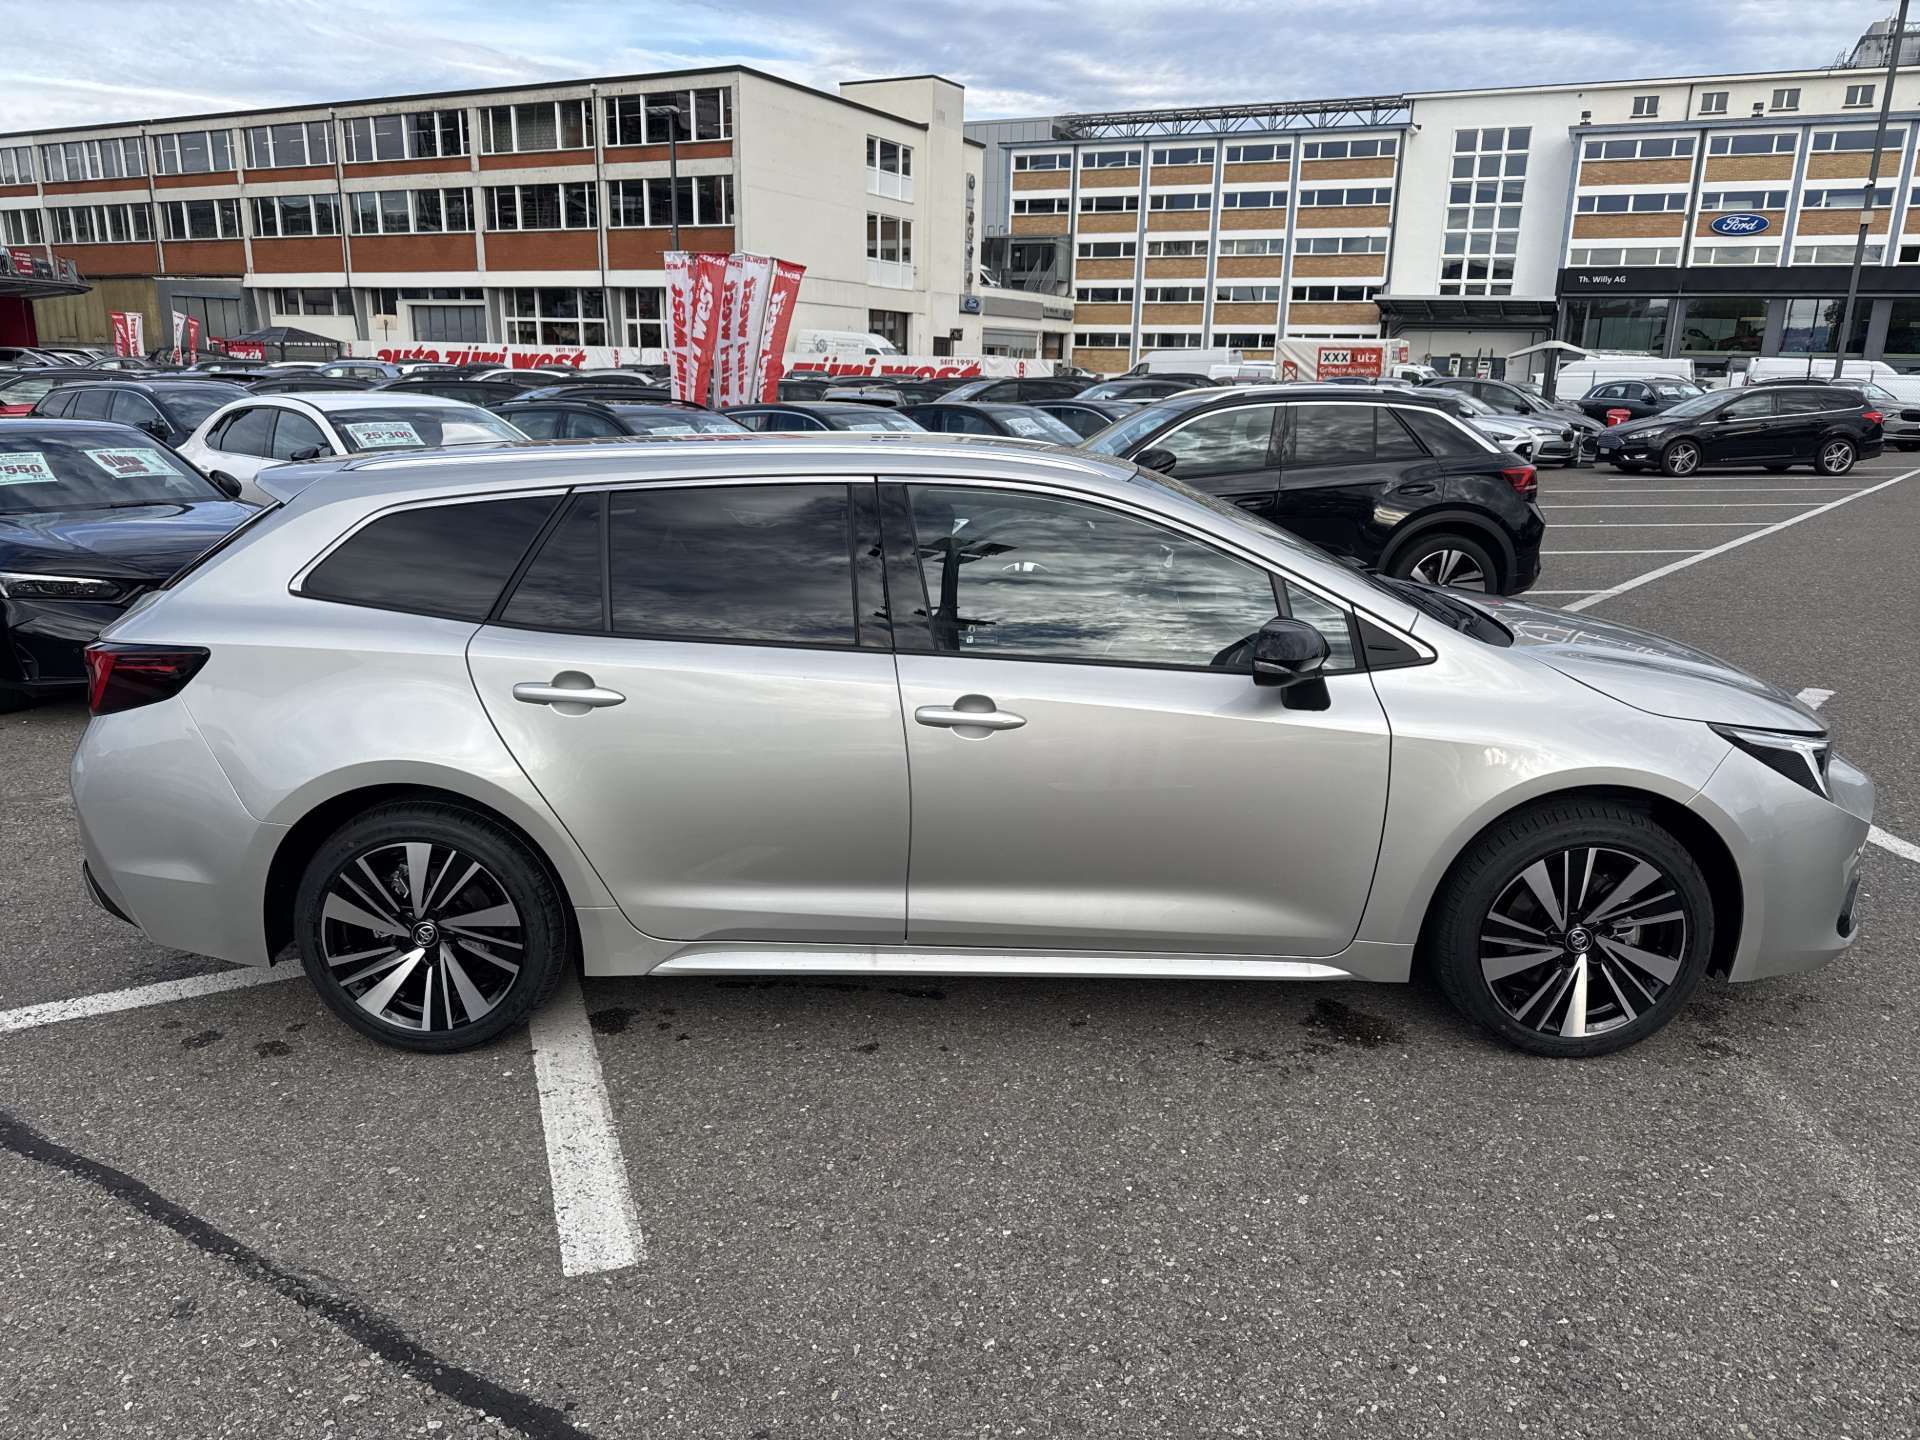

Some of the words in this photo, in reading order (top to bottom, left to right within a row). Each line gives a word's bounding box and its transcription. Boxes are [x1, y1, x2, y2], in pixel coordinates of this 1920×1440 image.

[1722, 216, 1757, 231] Ford
[1578, 275, 1590, 283] Th.
[1592, 275, 1613, 285] Willy
[1613, 275, 1627, 283] AG
[671, 282, 688, 347] west
[692, 273, 714, 340] west
[377, 344, 440, 364] auto
[445, 346, 509, 368] züri
[512, 349, 587, 371] west
[792, 356, 877, 377] züri
[880, 360, 982, 379] west
